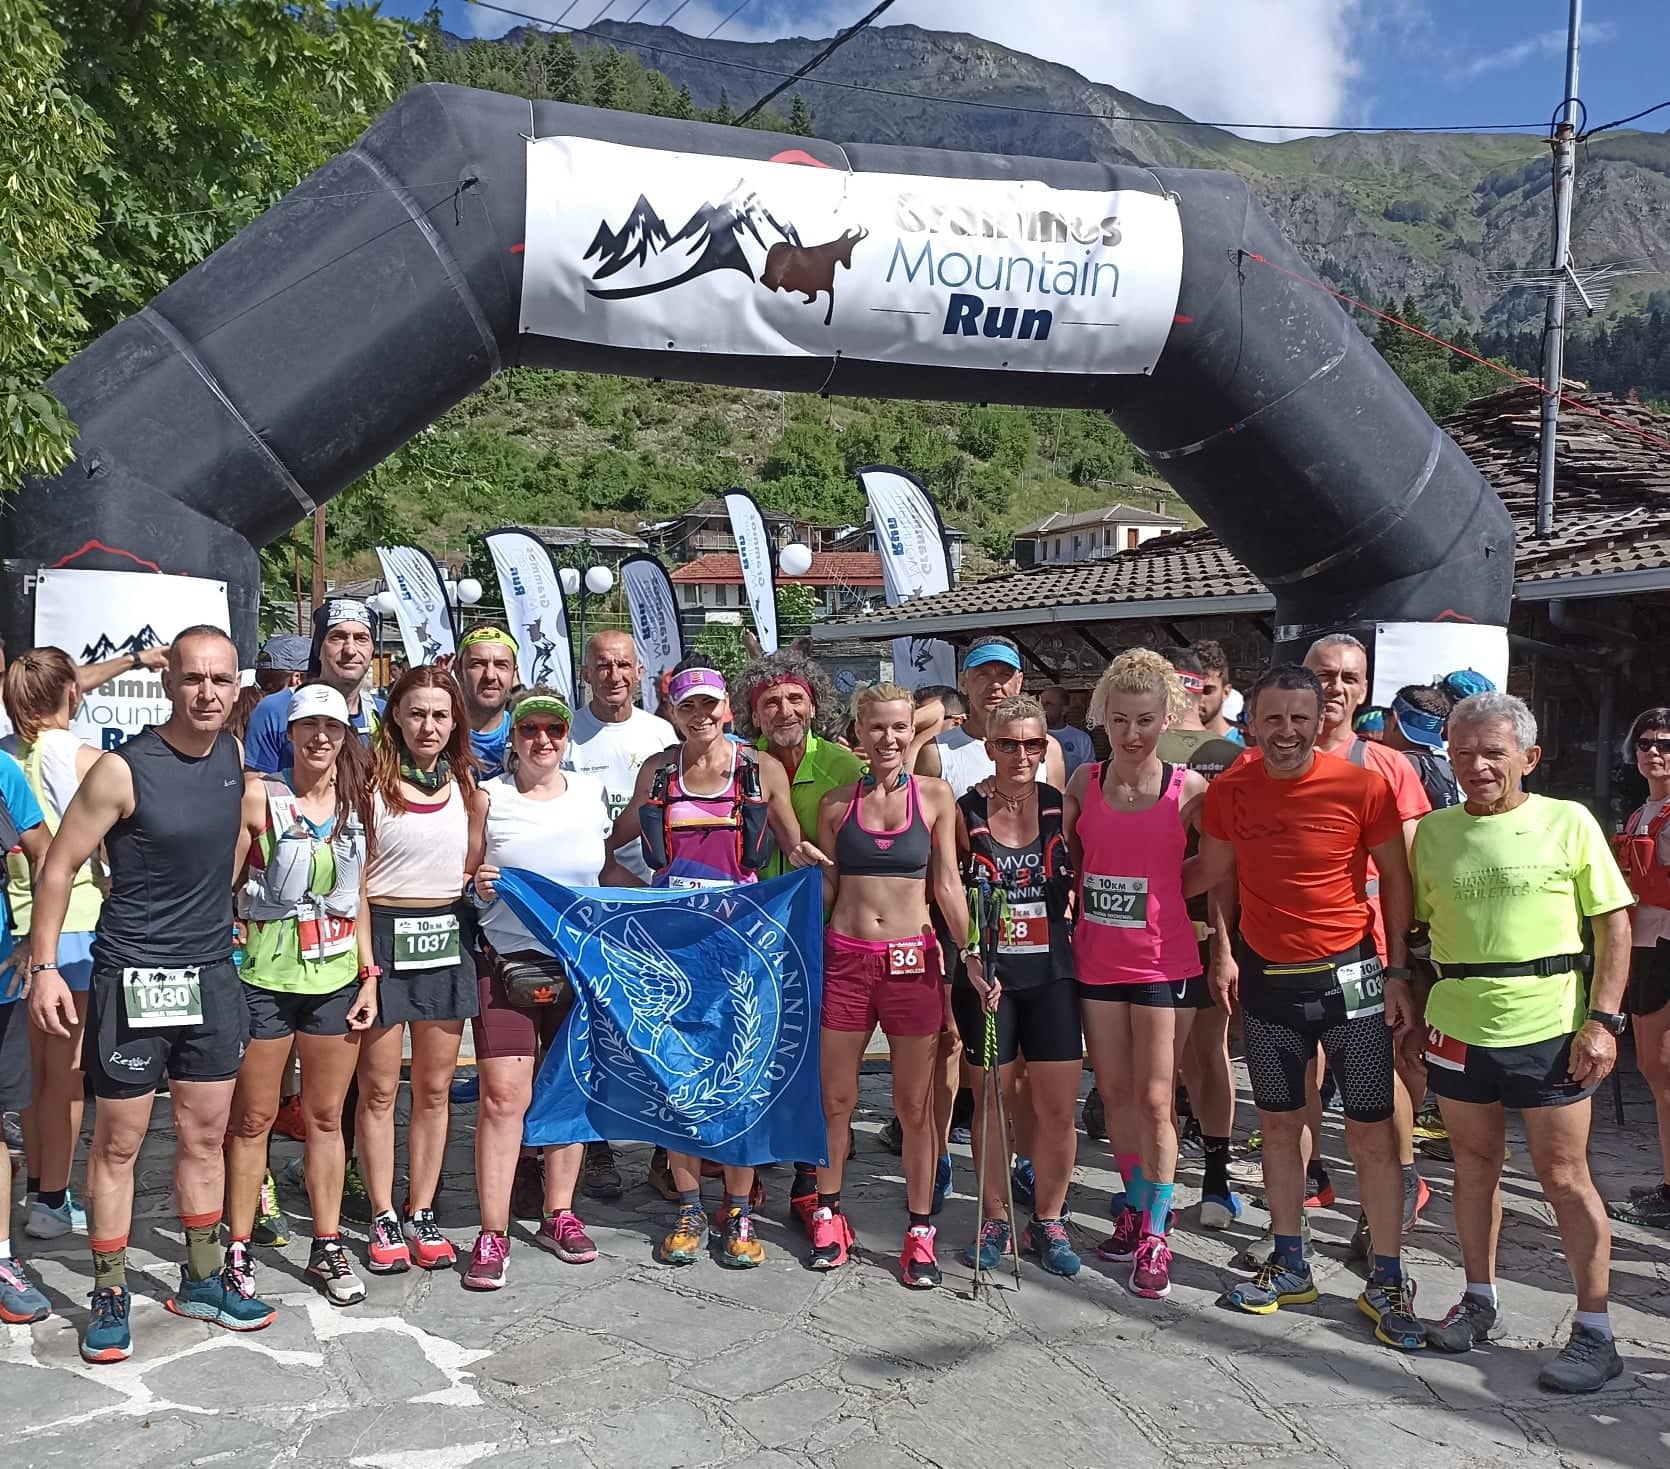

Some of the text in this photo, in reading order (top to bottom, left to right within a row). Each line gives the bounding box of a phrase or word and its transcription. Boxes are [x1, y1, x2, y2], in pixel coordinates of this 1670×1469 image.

[886, 237, 1120, 298] Mountain
[942, 293, 1053, 341] Run
[1091, 891, 1136, 912] 1027
[1004, 922, 1028, 939] 28
[407, 932, 450, 954] 1037
[892, 949, 918, 967] 36
[136, 986, 190, 1009] 1030
[1354, 973, 1385, 1000] 103
